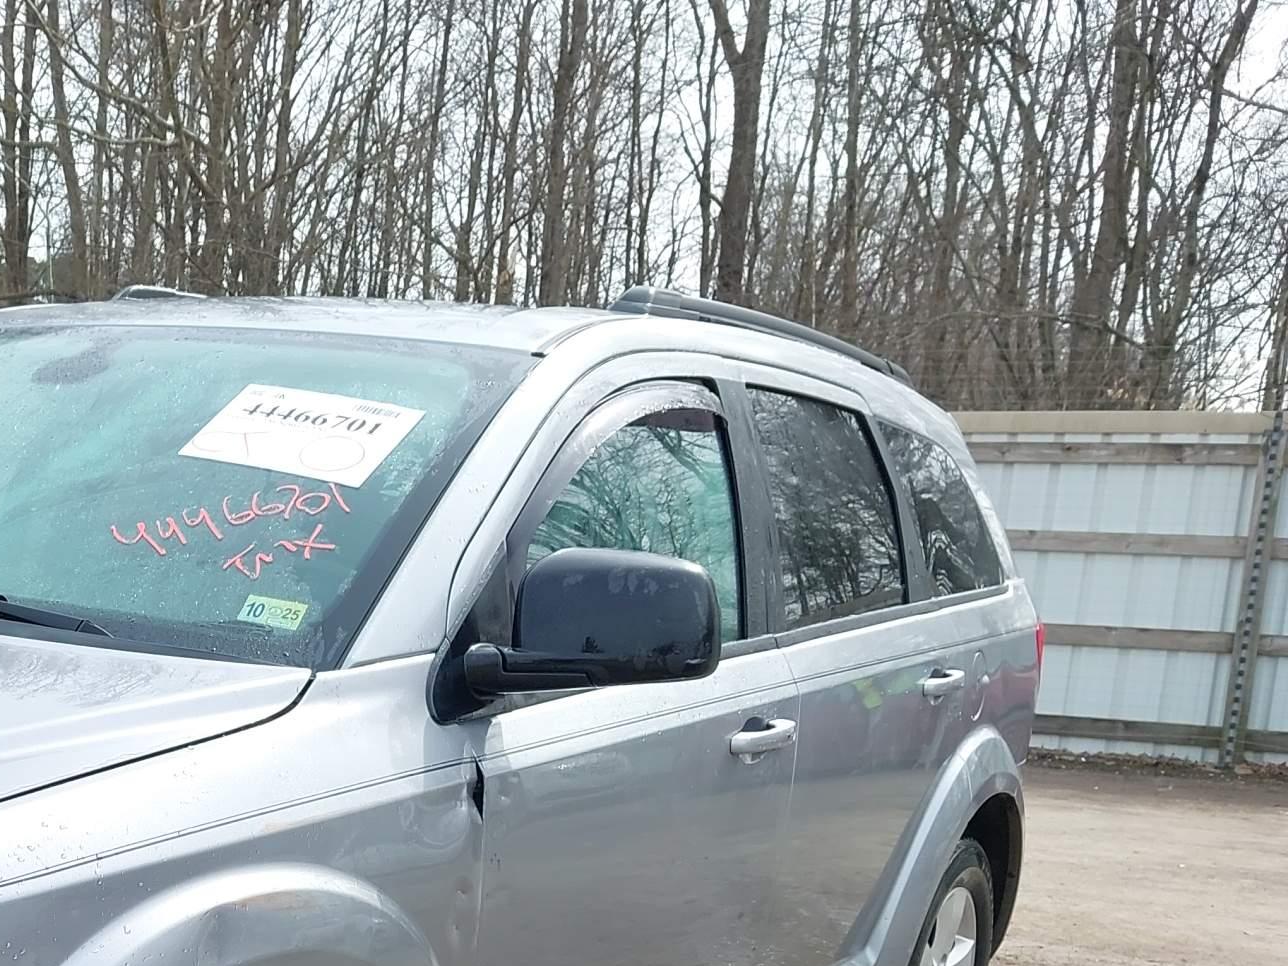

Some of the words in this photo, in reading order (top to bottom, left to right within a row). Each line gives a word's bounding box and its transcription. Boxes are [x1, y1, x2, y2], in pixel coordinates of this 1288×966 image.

[242, 403, 382, 435] 44466701
[110, 484, 351, 556] 44466701
[246, 602, 266, 618] 10
[281, 607, 301, 621] 25
